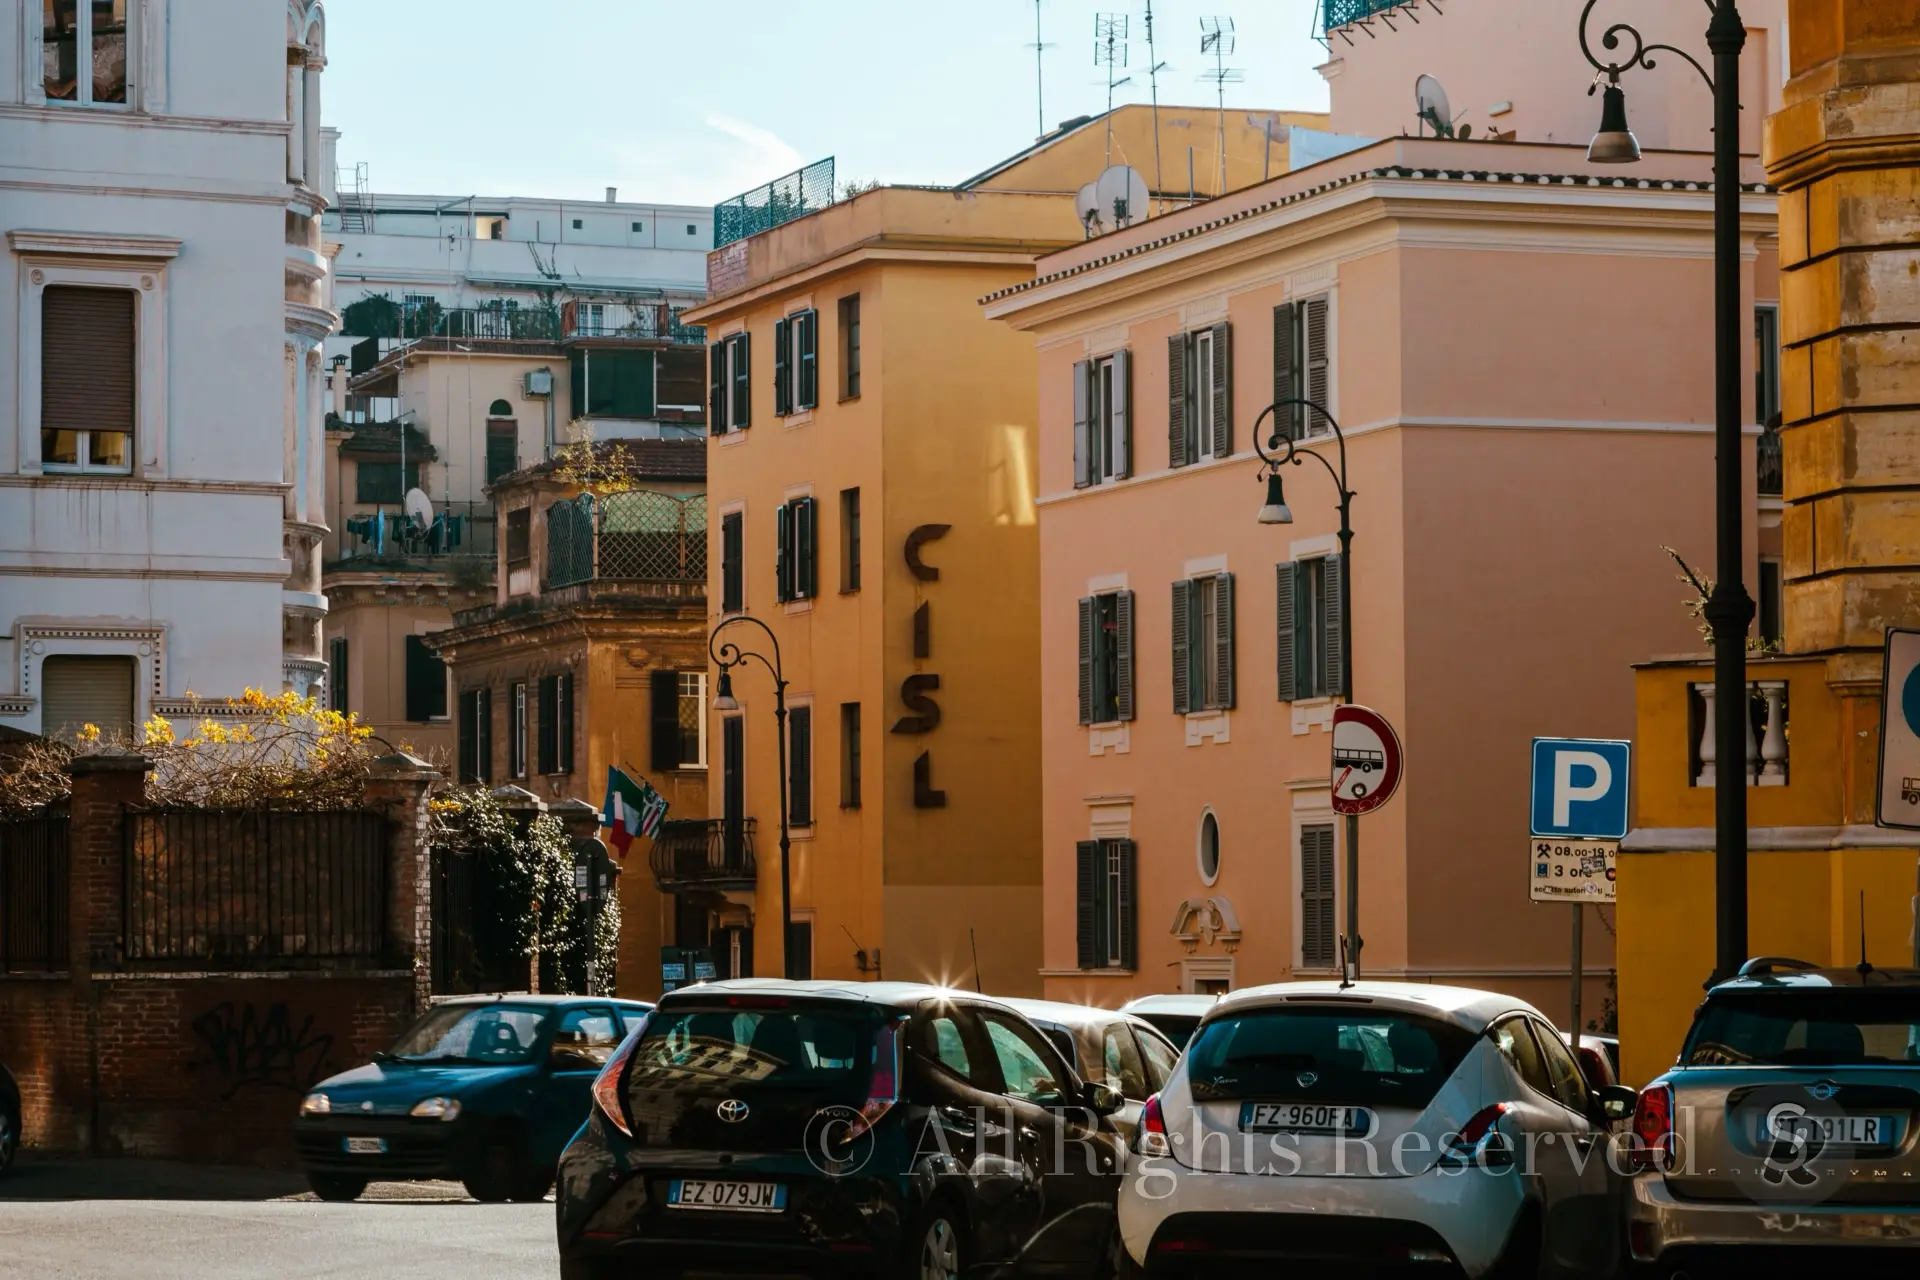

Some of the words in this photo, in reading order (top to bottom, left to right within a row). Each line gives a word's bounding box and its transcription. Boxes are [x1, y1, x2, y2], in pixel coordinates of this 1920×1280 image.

[889, 523, 953, 808] CISL
[1553, 750, 1612, 827] P
[1554, 865, 1563, 877] 3
